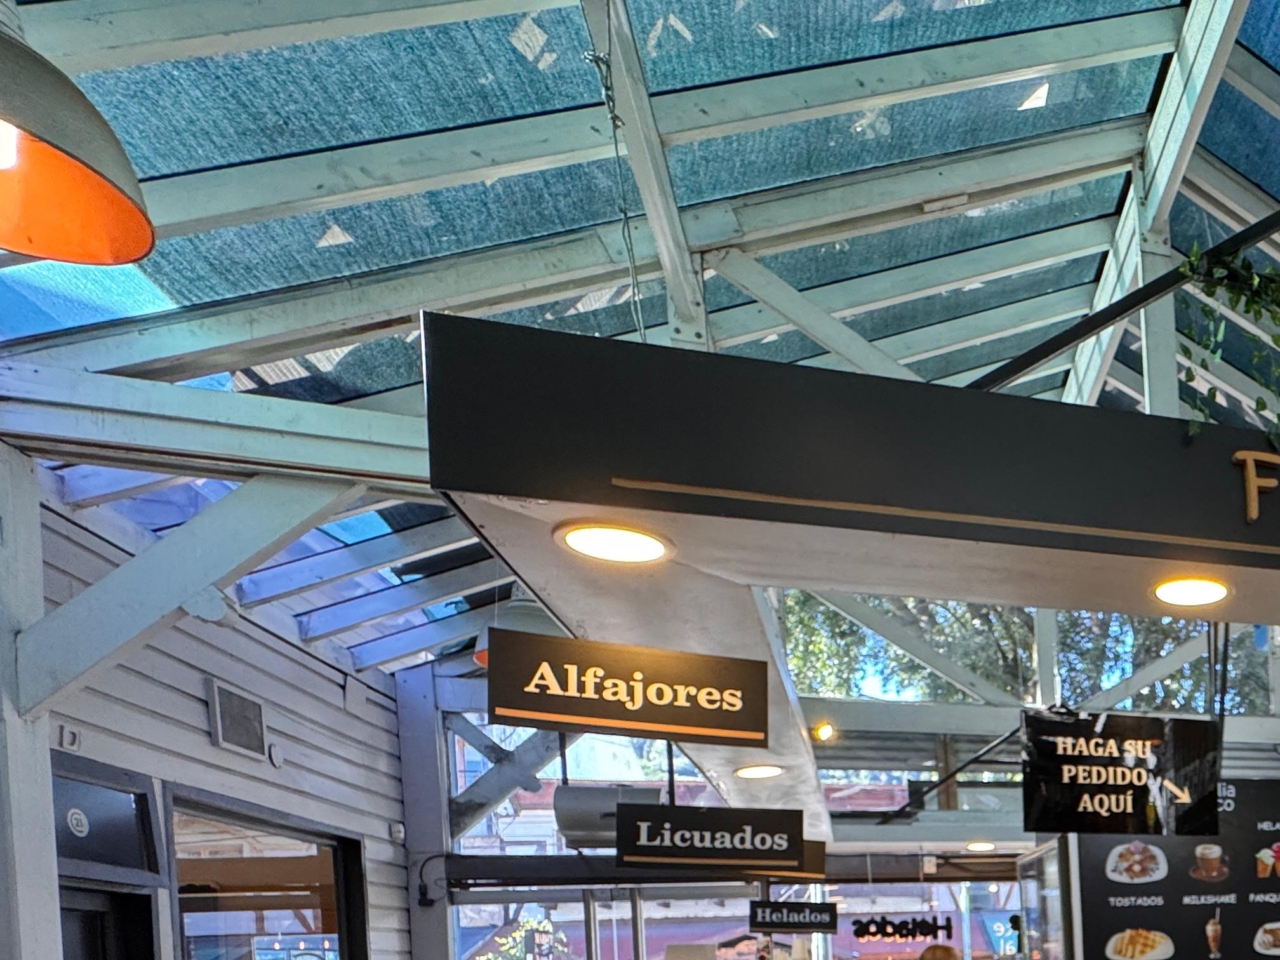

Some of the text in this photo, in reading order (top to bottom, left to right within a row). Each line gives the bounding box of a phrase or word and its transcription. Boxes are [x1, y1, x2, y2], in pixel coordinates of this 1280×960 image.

[523, 661, 744, 712] Alfajores
[1055, 736, 1153, 759] HAGA SU
[1061, 764, 1148, 787] PEDIDO
[1077, 789, 1135, 817] AQUÍ
[635, 821, 790, 852] Licuados
[1108, 896, 1164, 907] TOSTADOS
[755, 907, 831, 924] Helados
